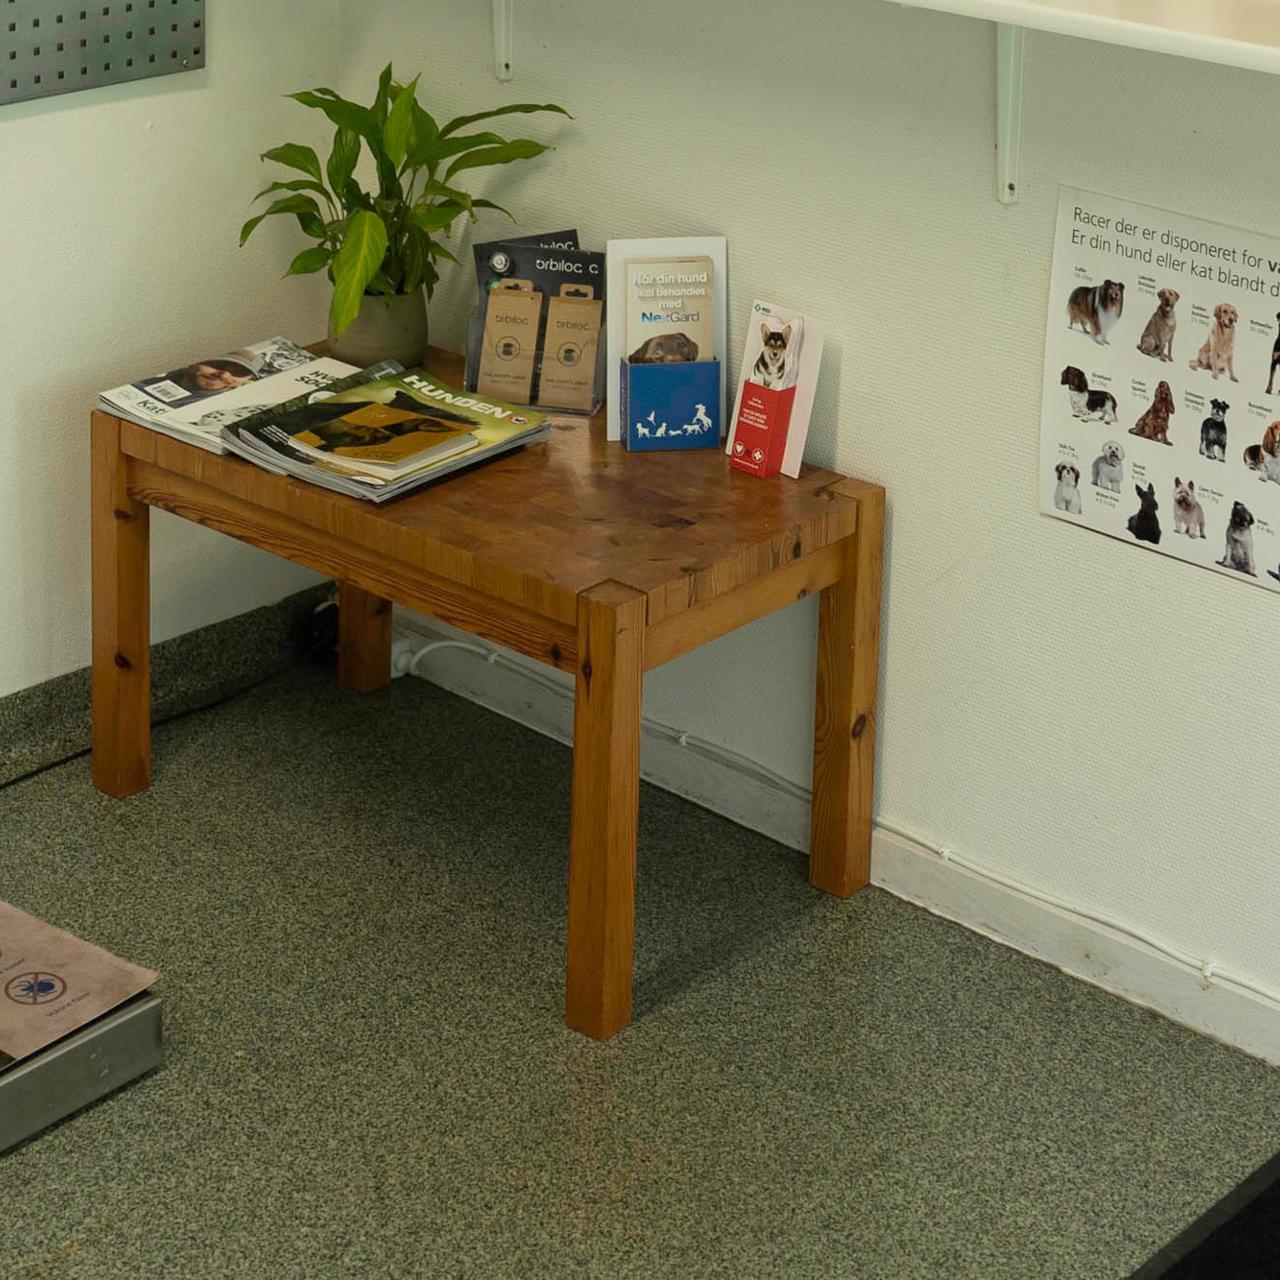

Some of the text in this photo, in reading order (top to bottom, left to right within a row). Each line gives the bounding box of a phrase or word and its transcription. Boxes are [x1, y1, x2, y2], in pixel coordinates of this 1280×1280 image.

[1074, 206, 1111, 230] Racer
[1115, 219, 1138, 237] der
[1142, 228, 1157, 241] er
[1160, 229, 1237, 263] disponeret
[1242, 249, 1264, 269] for
[536, 258, 583, 274] orbiloc
[1072, 229, 1086, 245] Er
[1090, 235, 1111, 252] din
[1115, 239, 1153, 263] hund
[1156, 253, 1187, 272] eller
[1190, 259, 1214, 281] kat
[1218, 266, 1266, 295] blandt
[678, 271, 707, 283] hund
[495, 315, 529, 326] orbiloc
[556, 320, 591, 331] orbiloc
[402, 374, 513, 419] HUNDEN
